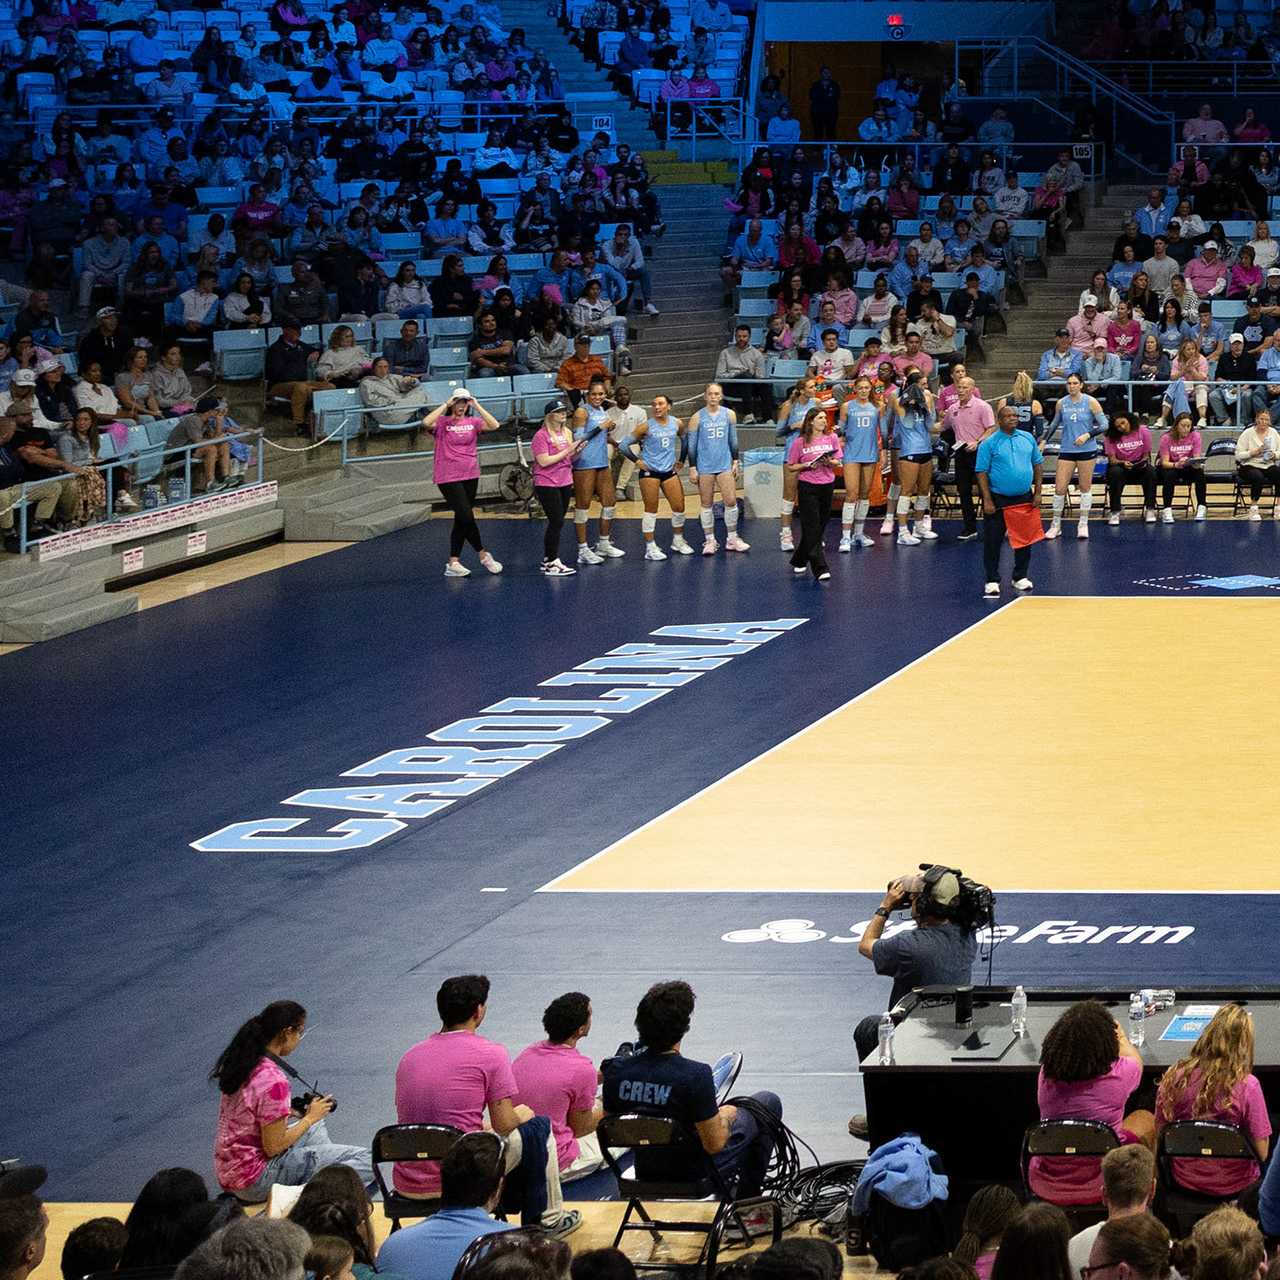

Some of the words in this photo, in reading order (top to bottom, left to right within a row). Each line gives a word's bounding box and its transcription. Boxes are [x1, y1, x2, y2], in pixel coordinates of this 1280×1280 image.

[594, 118, 610, 128] 104
[1074, 146, 1090, 157] 105
[856, 417, 870, 427] 10
[1070, 413, 1077, 423] 4
[707, 427, 724, 439] 36
[661, 437, 670, 448] 8
[189, 618, 810, 852] CAROLINA
[1012, 920, 1195, 945] Farm
[618, 1079, 673, 1107] CREW
